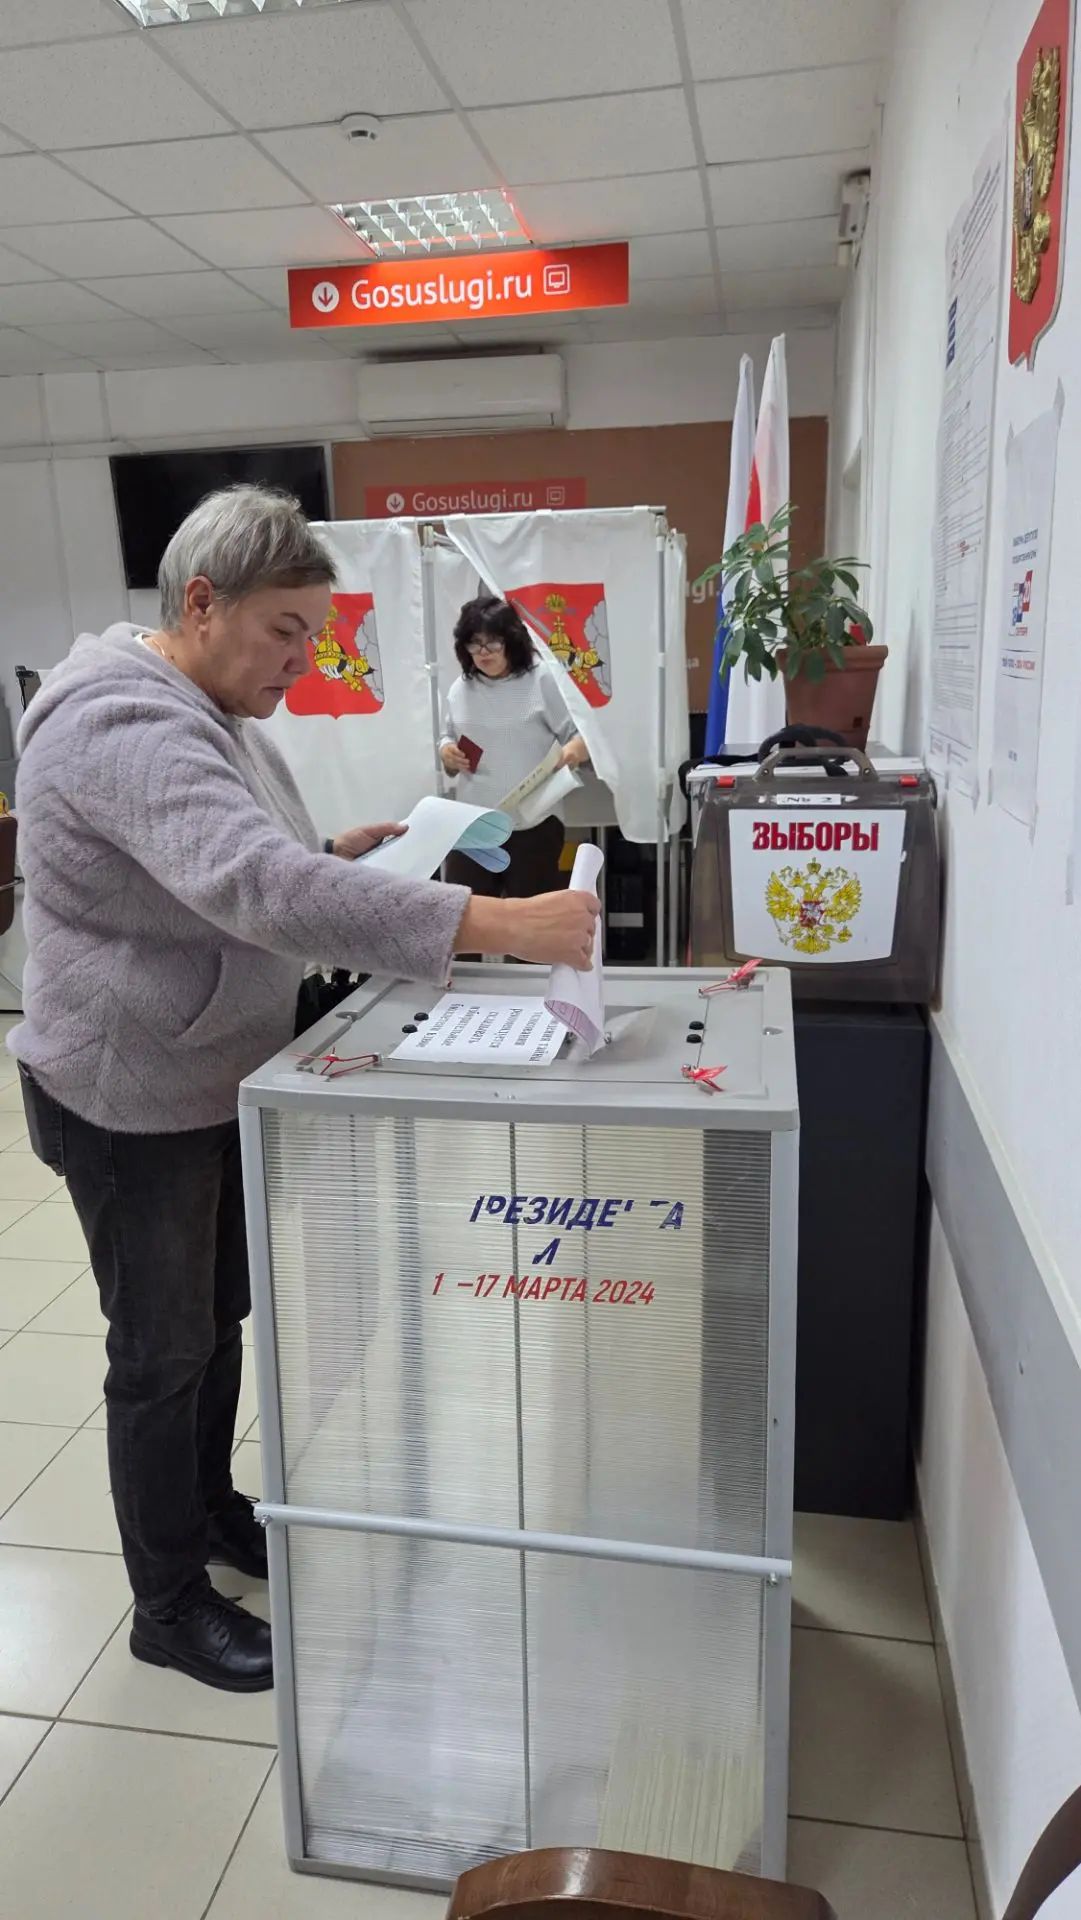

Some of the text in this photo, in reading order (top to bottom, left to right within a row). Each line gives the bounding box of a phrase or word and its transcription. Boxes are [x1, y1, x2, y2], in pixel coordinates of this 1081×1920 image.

[350, 270, 533, 310] Gosuslugi.ru
[411, 488, 533, 513] Gosuslugi.ru
[752, 822, 880, 851] ВЫБОРЫ
[503, 1275, 588, 1302] МАРТА
[592, 1279, 655, 1305] 2024
